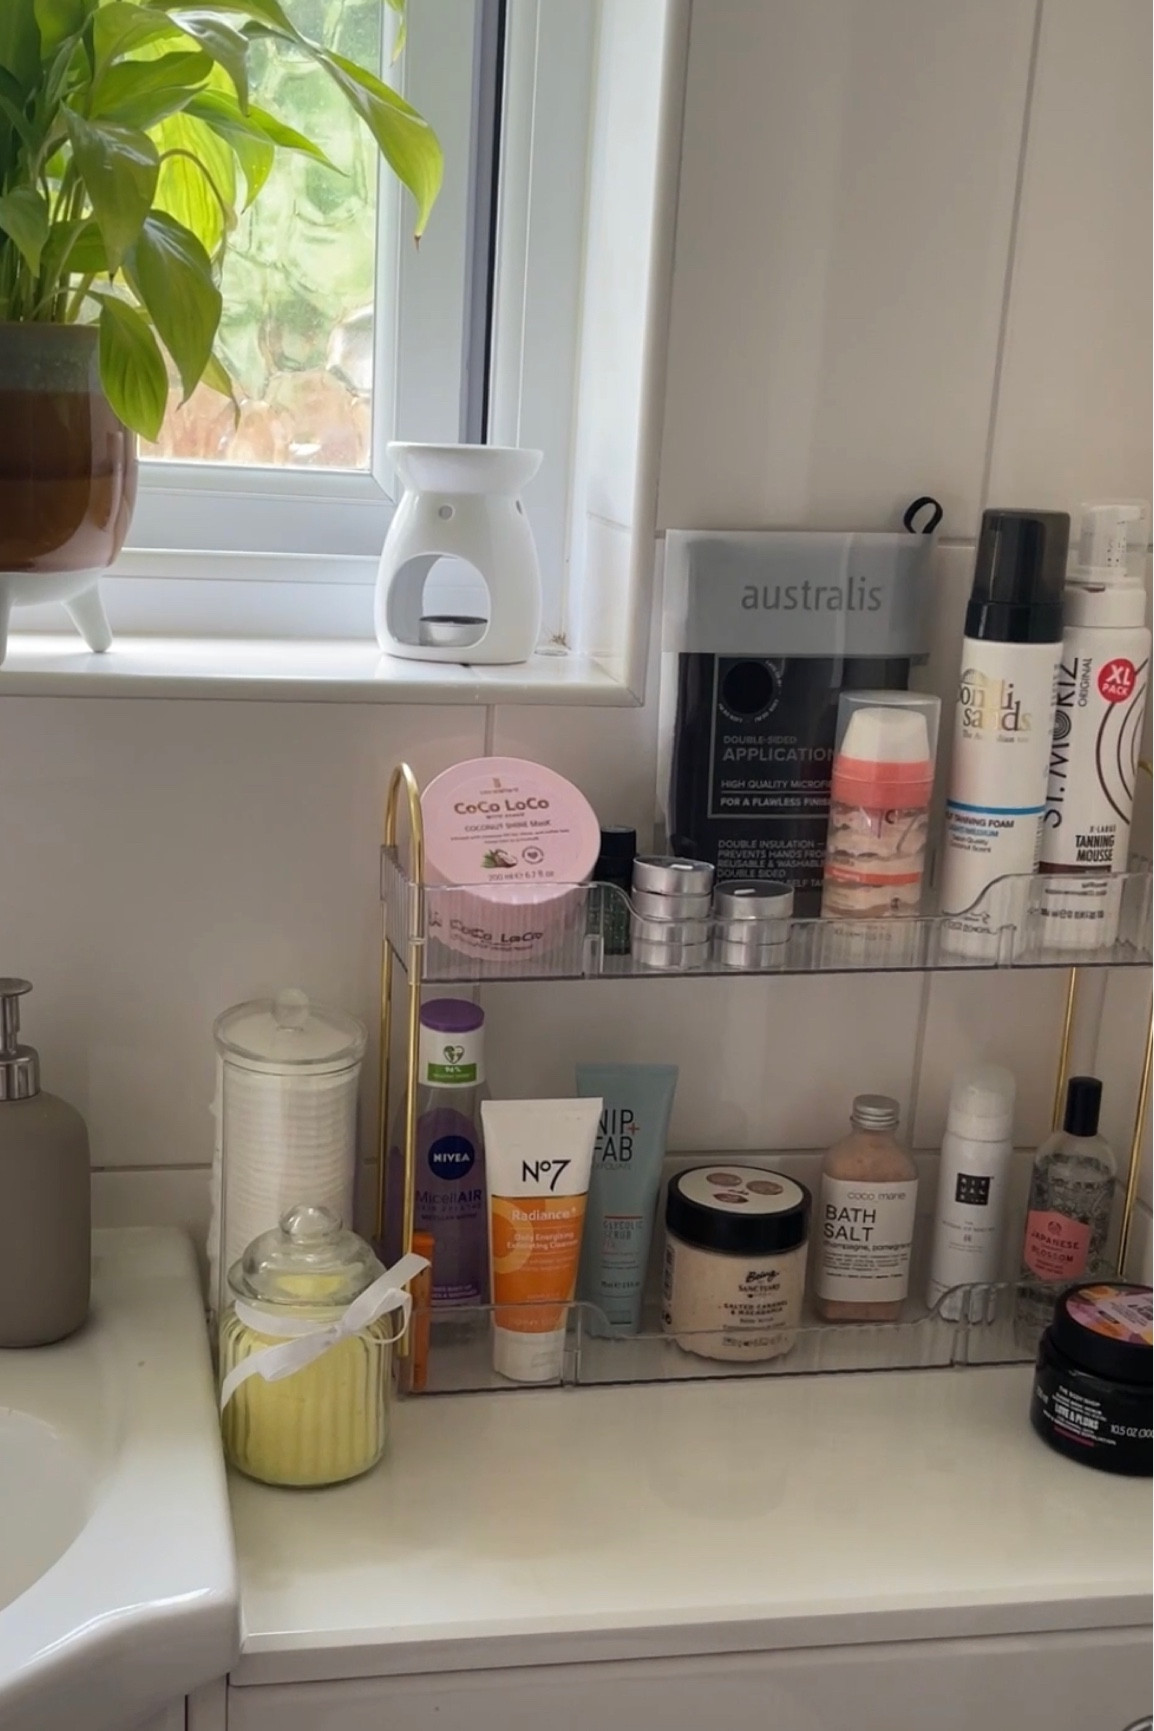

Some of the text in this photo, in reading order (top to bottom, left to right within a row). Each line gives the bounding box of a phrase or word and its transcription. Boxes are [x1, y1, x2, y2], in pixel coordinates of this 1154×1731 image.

[741, 576, 882, 611] australis
[1106, 665, 1130, 685] XL
[1078, 658, 1093, 707] ORIGINAL
[1102, 683, 1128, 696] PACK
[721, 780, 746, 789] HIGH
[748, 780, 787, 790] QUALITY
[720, 797, 740, 806] FOR
[742, 797, 750, 806] A
[752, 797, 801, 806] FLAWLESS
[988, 819, 1015, 828] FOAM
[718, 840, 757, 848] DOUBLE
[759, 840, 815, 848] INSULATION
[1075, 834, 1116, 848] TANNING
[718, 849, 766, 858] PREVENTS
[768, 849, 802, 858] HANDS
[1075, 848, 1114, 862] MOUSSE
[432, 1152, 470, 1163] NIVEA
[847, 1192, 875, 1200] coco
[825, 1204, 876, 1223] BATH
[823, 1223, 874, 1242] SALT
[745, 1270, 780, 1283] Being
